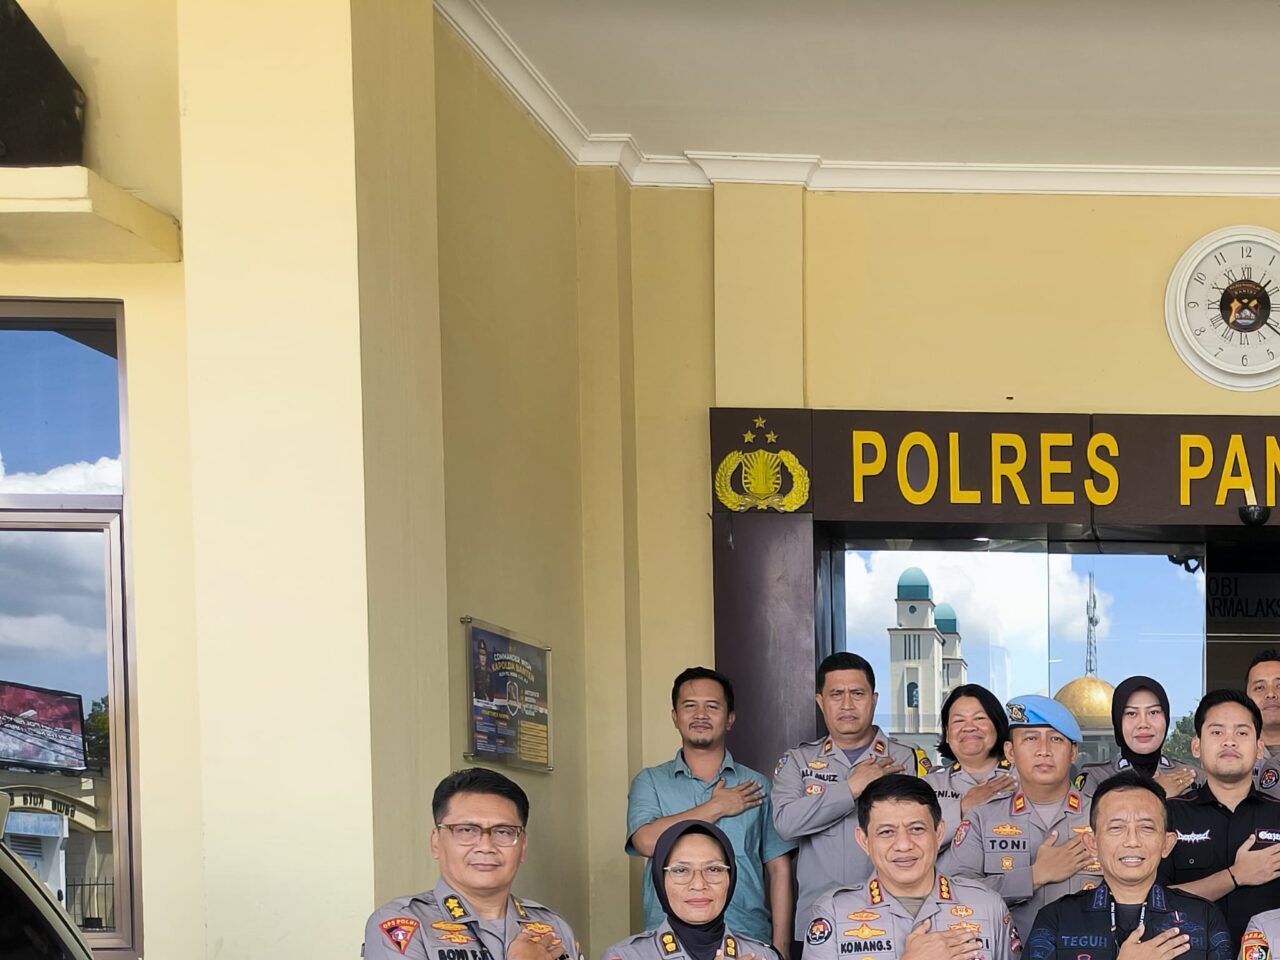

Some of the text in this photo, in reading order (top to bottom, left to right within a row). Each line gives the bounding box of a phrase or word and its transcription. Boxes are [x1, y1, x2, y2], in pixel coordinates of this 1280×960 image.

[1241, 246, 1252, 258] 12
[1214, 252, 1227, 266] 11
[1193, 272, 1207, 285] 10
[1187, 301, 1200, 309] 9
[1194, 327, 1206, 337] 8
[1214, 347, 1224, 358] 7
[1266, 348, 1275, 361] 5
[1241, 354, 1249, 367] 6
[852, 429, 1120, 506] POLRES
[989, 839, 1027, 850] TONI
[840, 939, 893, 954] KOMANG.S
[1061, 935, 1108, 948] TEGUH
